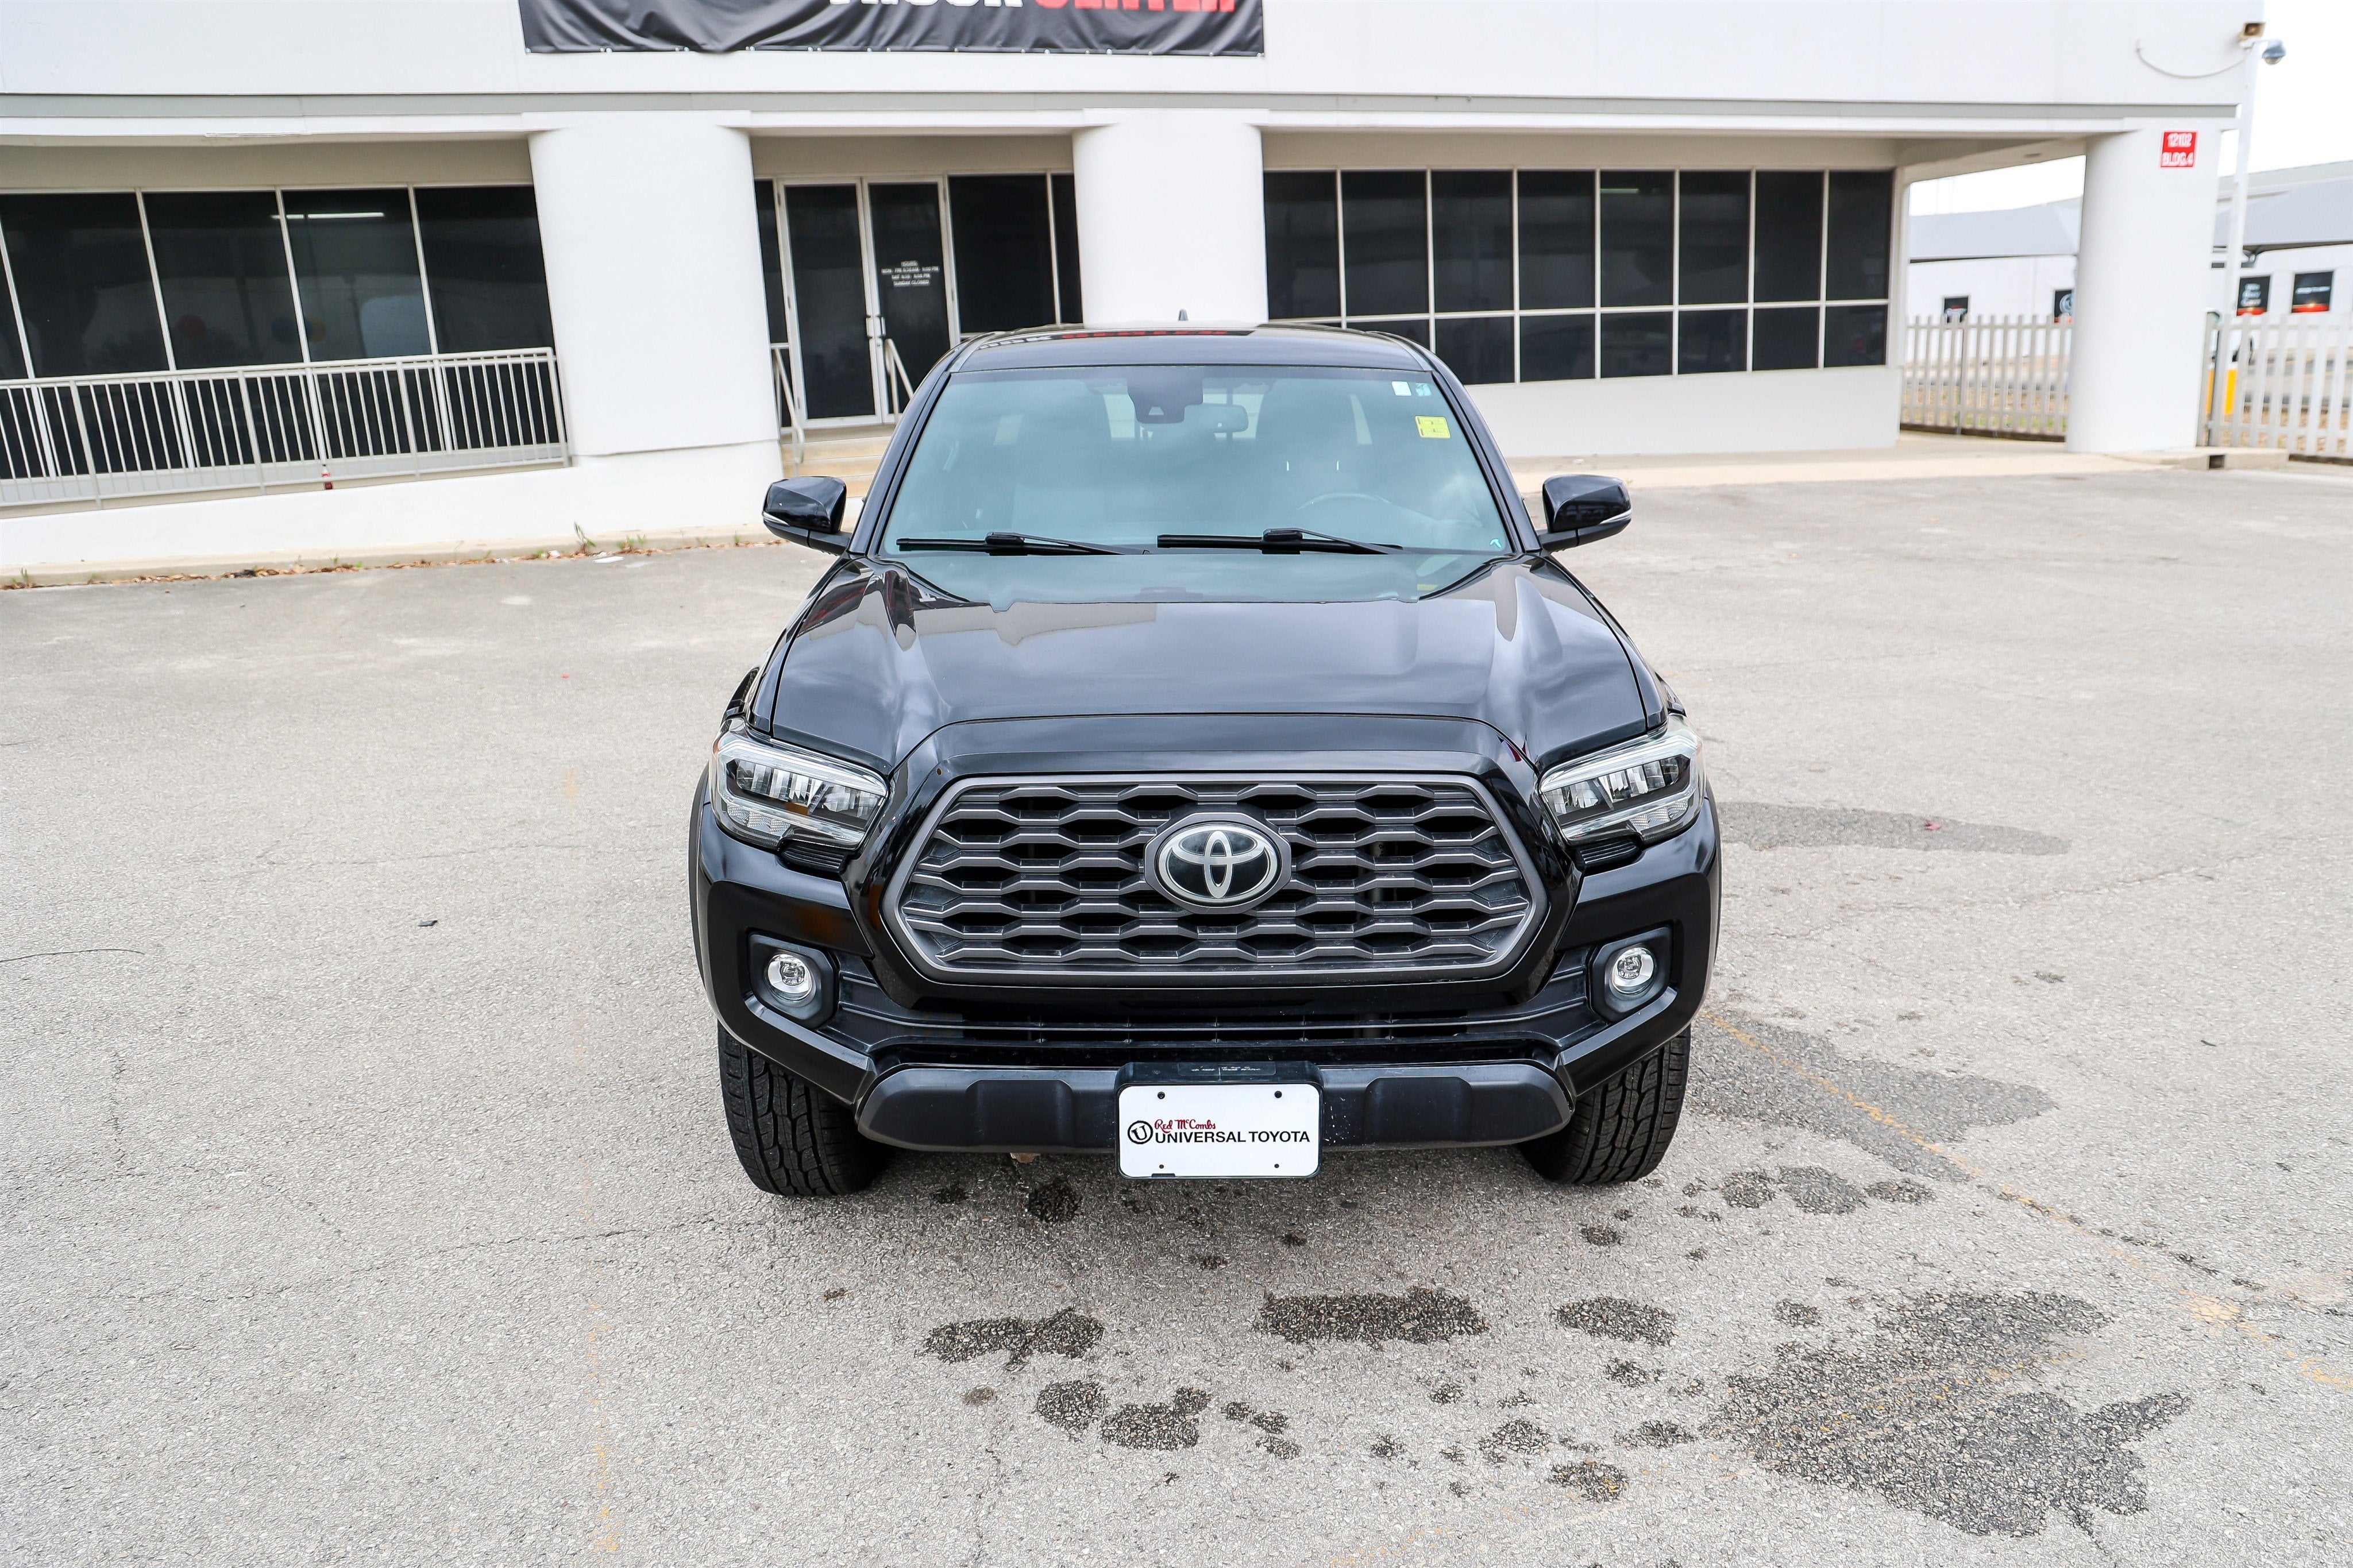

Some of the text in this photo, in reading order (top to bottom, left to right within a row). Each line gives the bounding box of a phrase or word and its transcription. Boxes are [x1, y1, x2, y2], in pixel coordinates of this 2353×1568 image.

[1154, 1119, 1216, 1133] Red McCombs
[1155, 1130, 1310, 1144] UNIVERSAL TOYOTA
